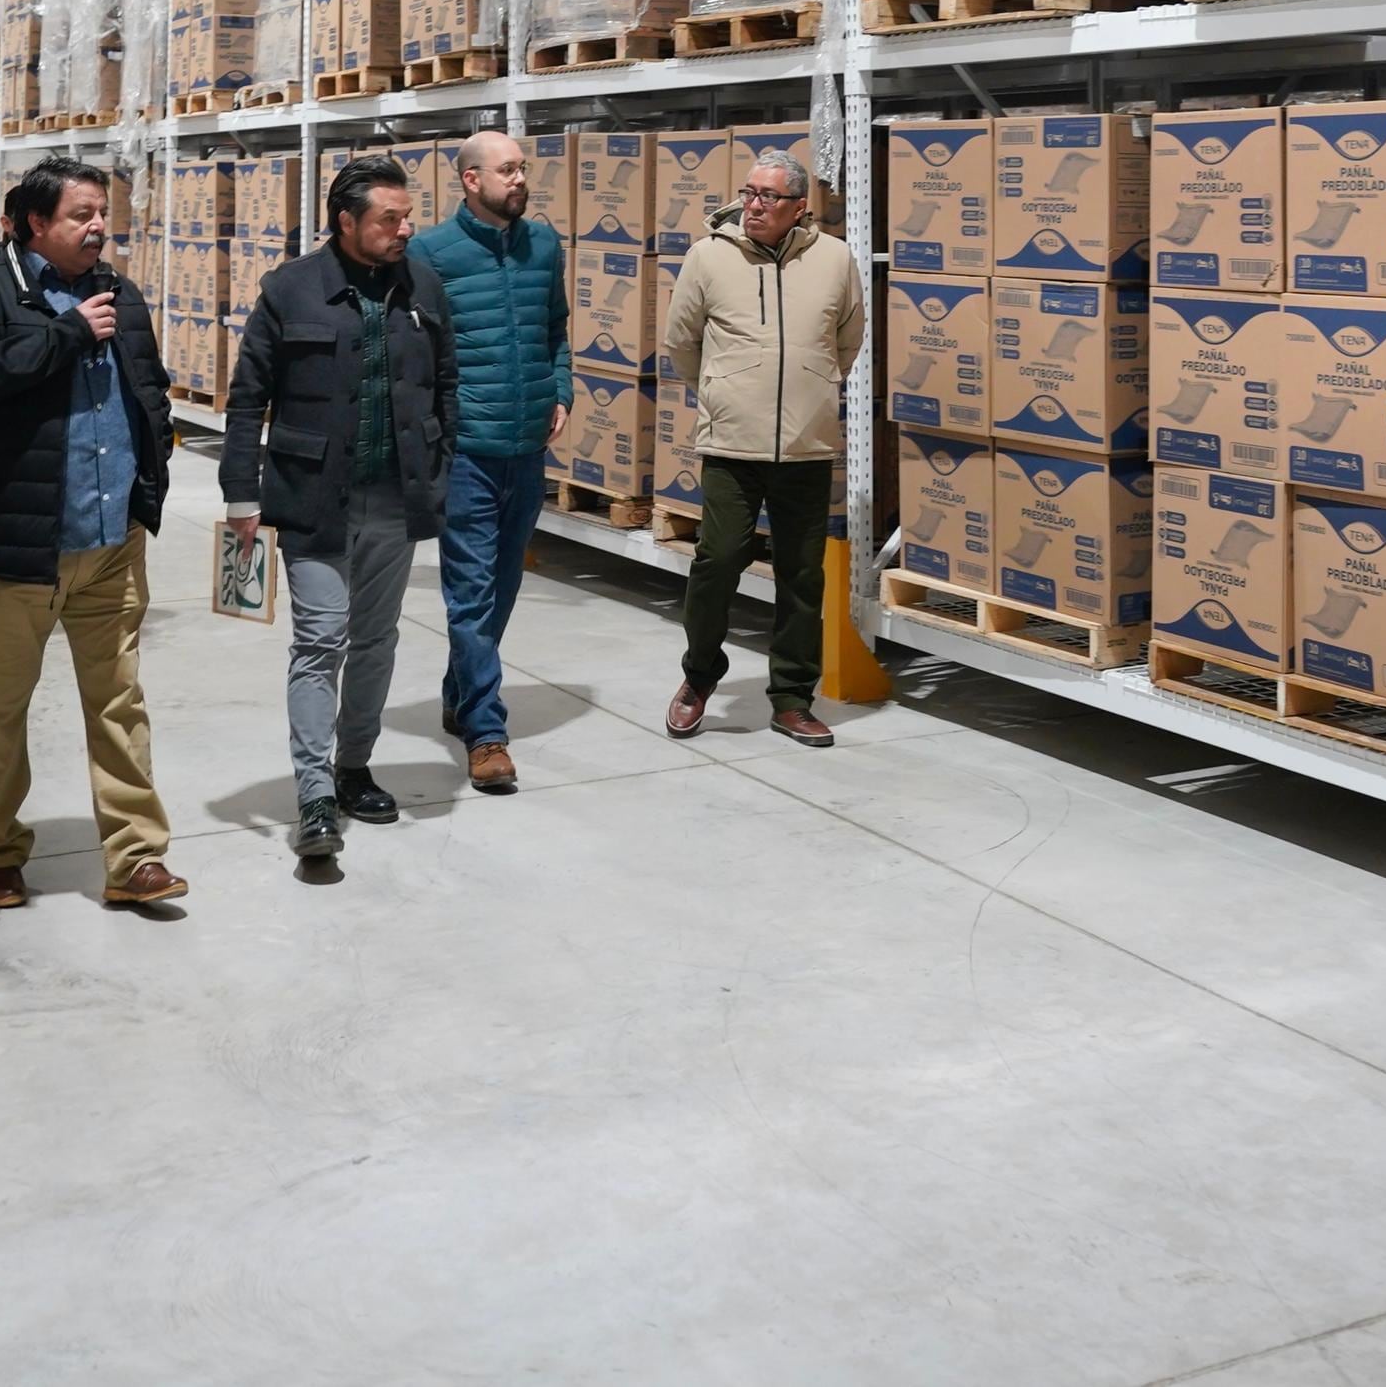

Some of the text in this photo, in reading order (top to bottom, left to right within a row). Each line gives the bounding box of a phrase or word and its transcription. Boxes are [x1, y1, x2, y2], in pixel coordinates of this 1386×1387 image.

[1345, 140, 1369, 148] TENA
[1200, 146, 1221, 154] TENA
[1180, 183, 1242, 192] PREDOBLADO
[1202, 324, 1223, 333] TENA
[1340, 335, 1366, 345] TENA
[1182, 361, 1245, 375] PREDOBLADO
[1350, 531, 1374, 542] TENA
[1183, 565, 1246, 586] PREDOBLADO
[1203, 609, 1224, 622] TENA
